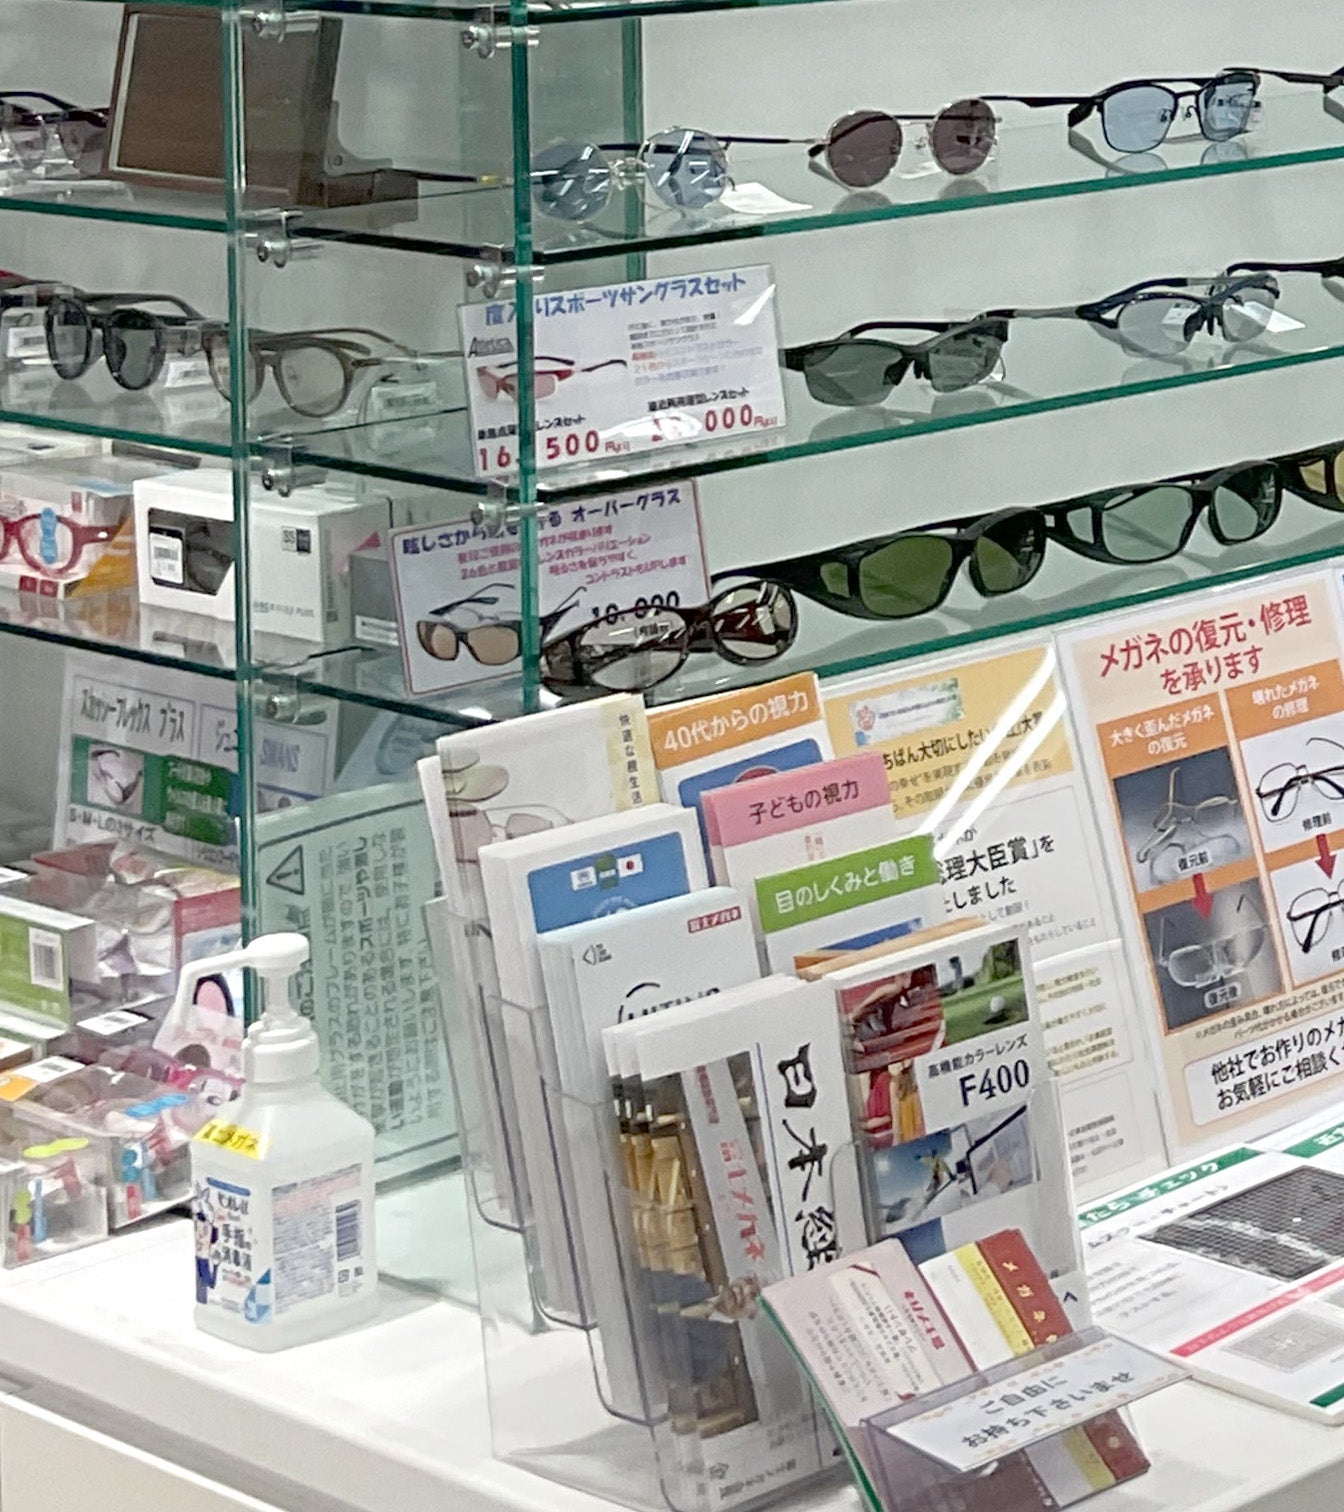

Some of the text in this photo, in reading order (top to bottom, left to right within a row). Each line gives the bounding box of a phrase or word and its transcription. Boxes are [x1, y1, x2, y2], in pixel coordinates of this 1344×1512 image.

[572, 489, 681, 521] オーバーグラス
[1099, 594, 1312, 678] メガネの復元・修理
[1160, 645, 1265, 697] を承ります
[664, 691, 809, 752] 40代からの視力
[1109, 705, 1215, 749] 大きく歪んだメガネ
[1272, 697, 1309, 720] の修理
[1148, 732, 1188, 756] の復元
[749, 780, 859, 825] 子どもの視力
[775, 854, 915, 914] 目のしくみと働き
[960, 1059, 1031, 1106] F400
[962, 1372, 1135, 1449] お持ち下さいませ
[980, 1376, 1069, 1415] ご自由に
